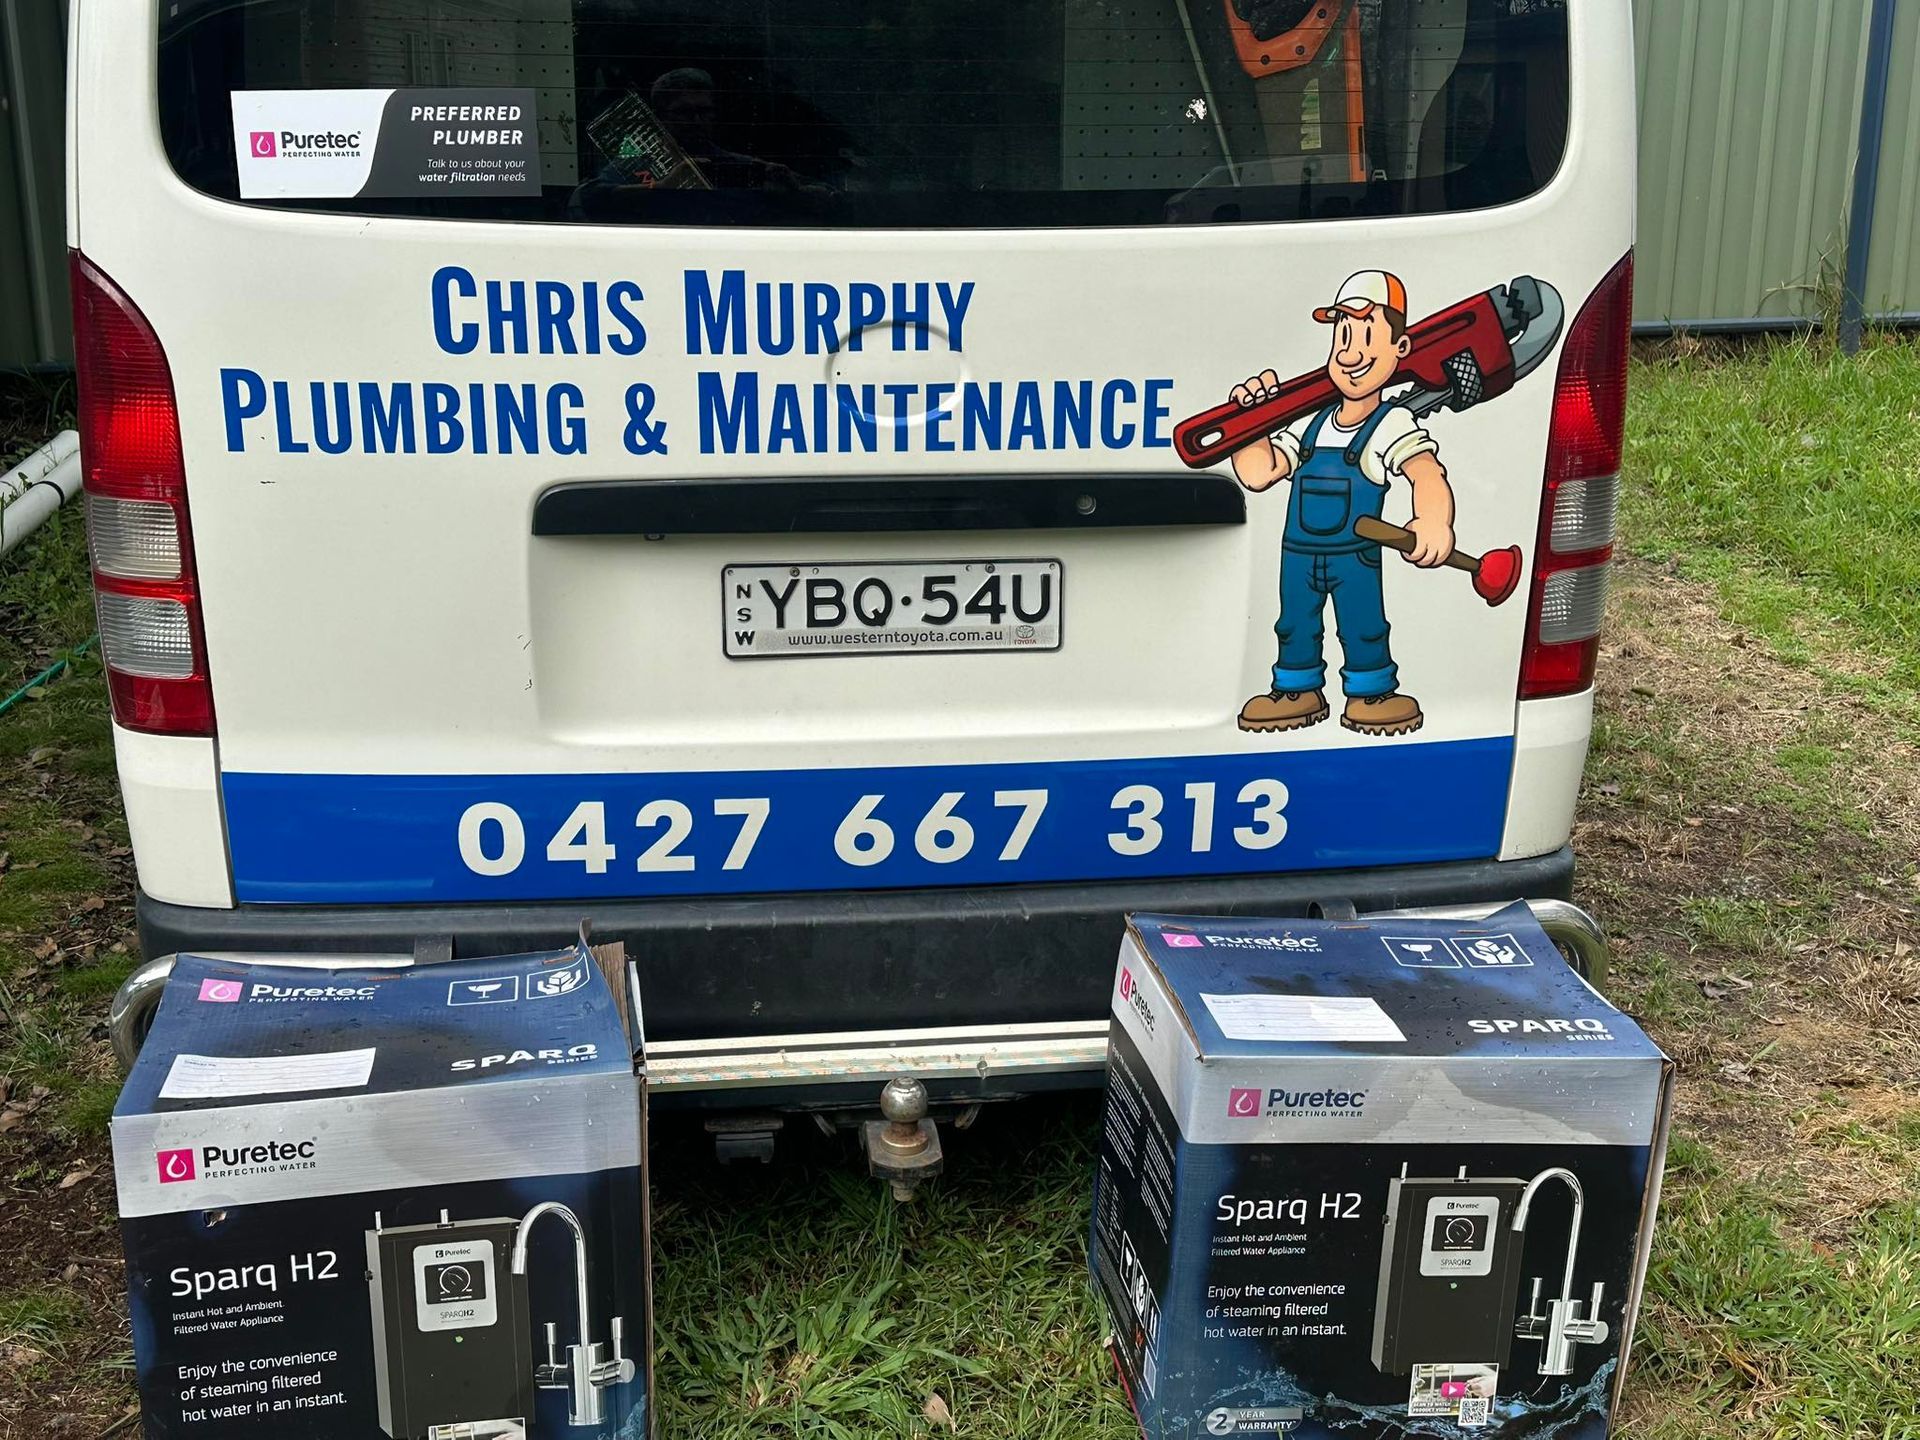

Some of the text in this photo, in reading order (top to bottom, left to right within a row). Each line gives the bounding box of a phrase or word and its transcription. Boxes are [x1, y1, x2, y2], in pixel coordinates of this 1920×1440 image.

[411, 106, 521, 121] PREFERRED
[281, 131, 360, 149] Puretec
[433, 130, 523, 145] PLUMBER
[427, 159, 446, 168] Talk
[449, 160, 458, 168] to
[475, 159, 501, 168] about
[504, 160, 525, 169] your
[419, 172, 526, 183] water filtration needs
[431, 266, 975, 356] CHRIS MURPHY
[220, 368, 1174, 456] PLUMBING & MAINTENANCE
[788, 629, 1003, 646] www.westerntoyota.com.au
[457, 778, 1289, 877] 0427 667 313
[1205, 936, 1318, 948] Puretec
[250, 984, 376, 997] Puretec
[1467, 1018, 1608, 1033] SPARQ
[450, 1044, 598, 1071] SPARQ
[1268, 1088, 1366, 1108] Puretec
[202, 1141, 315, 1168] Puretec
[205, 1162, 316, 1179] PERFECTING WATER
[1216, 1192, 1362, 1226] Sparq H2
[1212, 1233, 1307, 1243] Instant Hot and Ambient
[1212, 1246, 1306, 1256] Filtered Water Appliance
[170, 1250, 338, 1300] Sparq H2
[1208, 1284, 1346, 1300] Enjoy the convenience
[172, 1310, 204, 1321] Instant
[206, 1307, 224, 1316] Hot
[226, 1304, 243, 1314] and
[1206, 1302, 1328, 1318] of steaming filtered
[174, 1314, 284, 1335] Filtered Water Appliance
[1204, 1324, 1347, 1338] hot water in an instant.
[178, 1350, 338, 1380] Enjoy the convenience
[180, 1371, 322, 1400] of steaming filtered
[182, 1391, 348, 1422] hot water in an instant.
[1239, 1410, 1265, 1418] YEAR
[1214, 1414, 1228, 1430] 2
